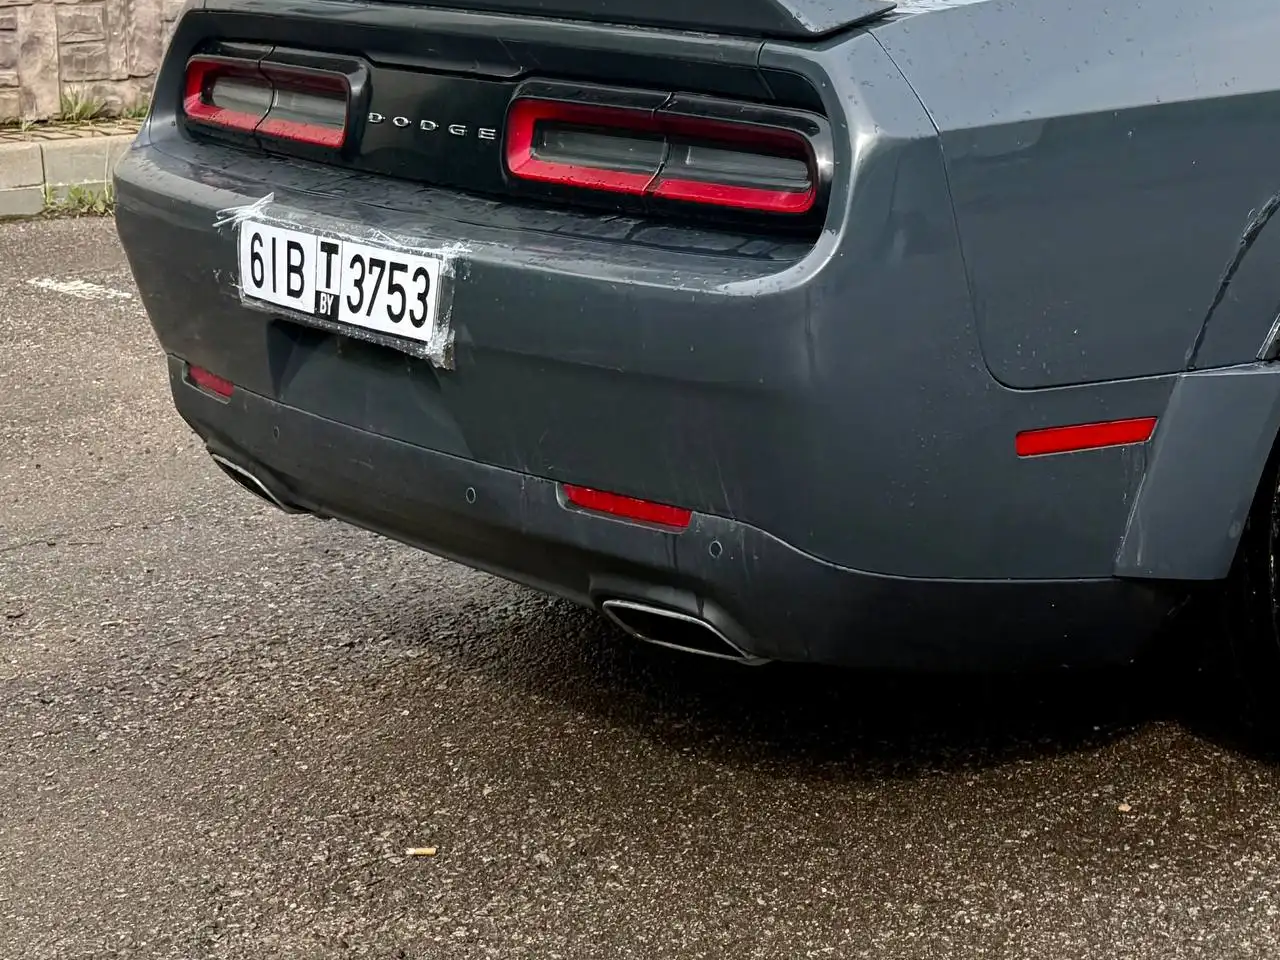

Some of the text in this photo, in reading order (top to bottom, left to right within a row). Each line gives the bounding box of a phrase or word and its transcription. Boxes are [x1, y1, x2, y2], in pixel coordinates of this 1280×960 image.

[368, 112, 496, 139] DODGE
[319, 292, 335, 316] BY
[346, 254, 430, 328] 3753
